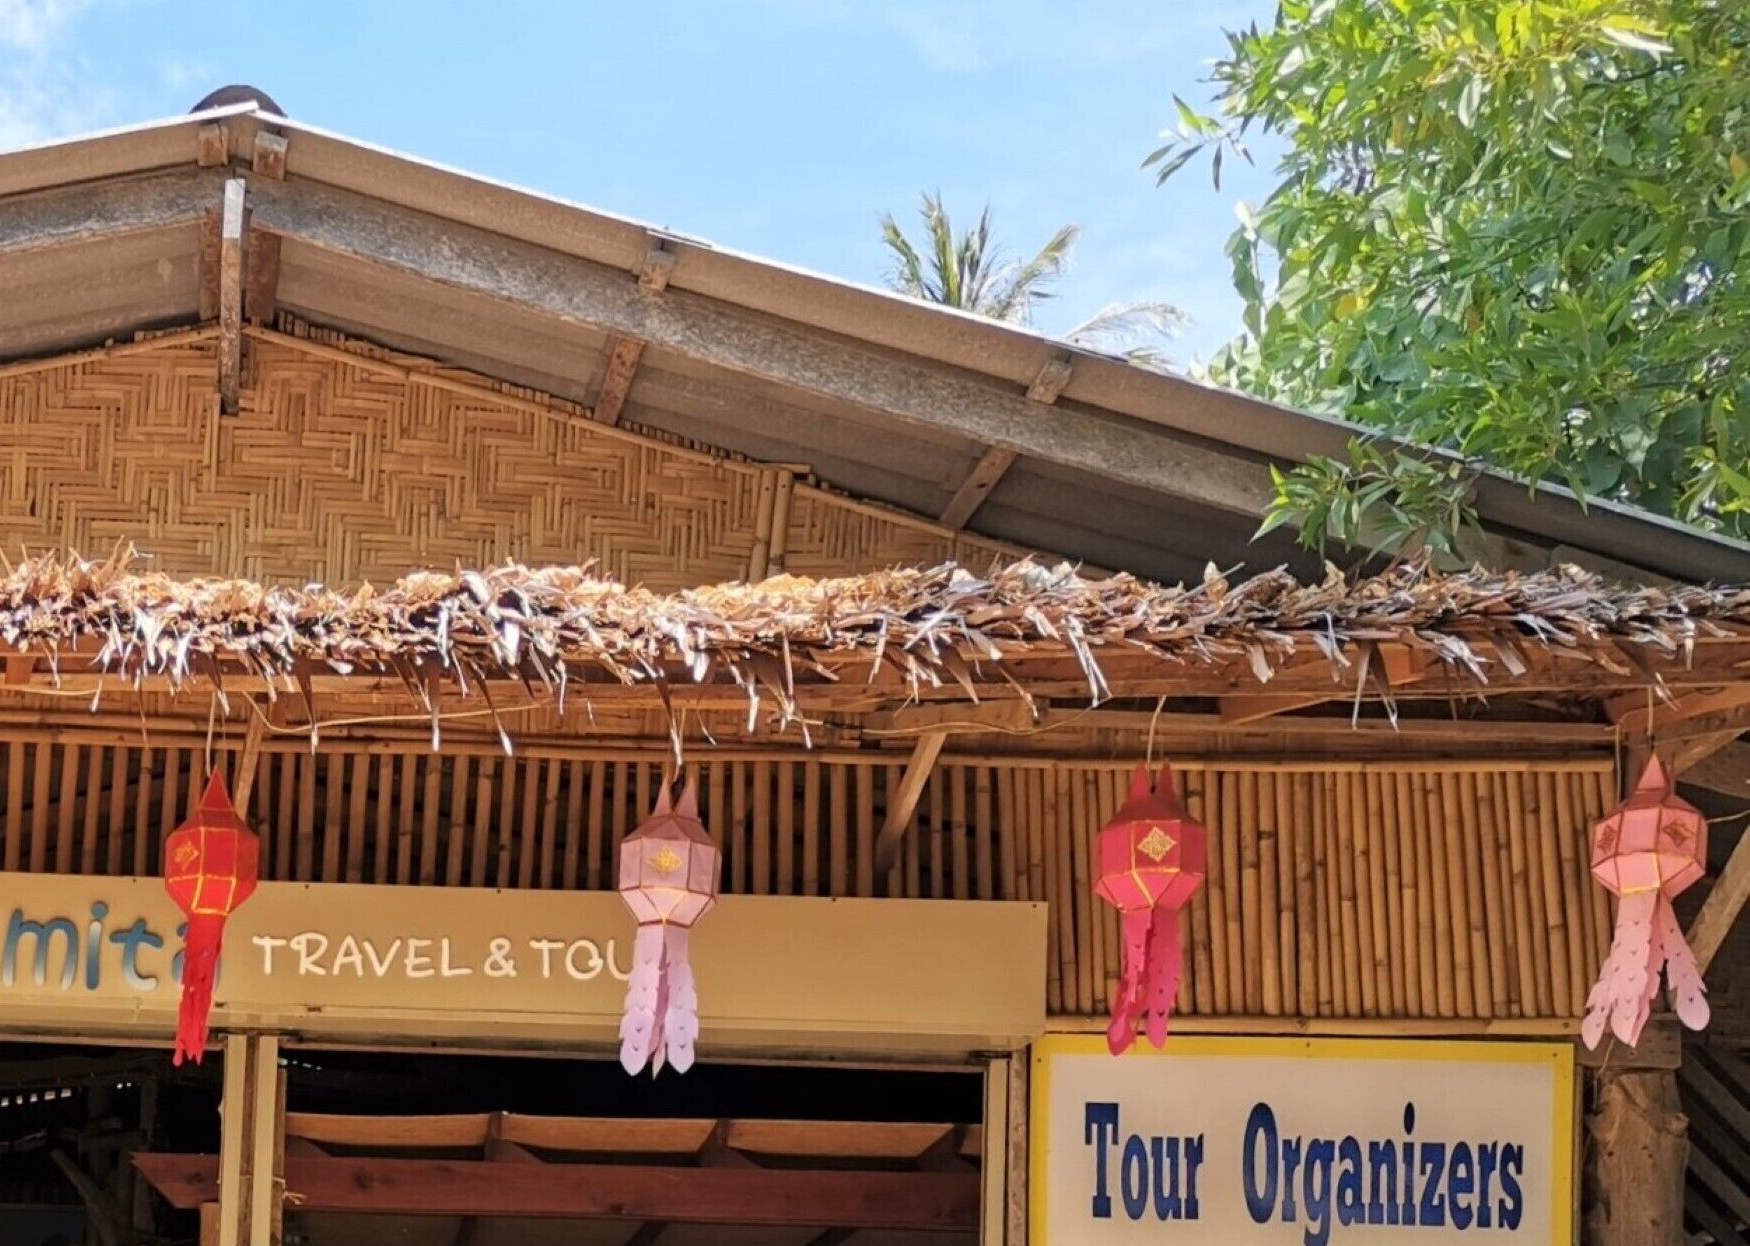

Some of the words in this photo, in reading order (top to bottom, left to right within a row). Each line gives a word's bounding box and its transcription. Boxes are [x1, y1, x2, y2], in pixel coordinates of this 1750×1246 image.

[252, 932, 472, 978] TRAVEL
[483, 937, 517, 978] &
[529, 938, 635, 981] TOU
[1084, 1101, 1204, 1221] Tour
